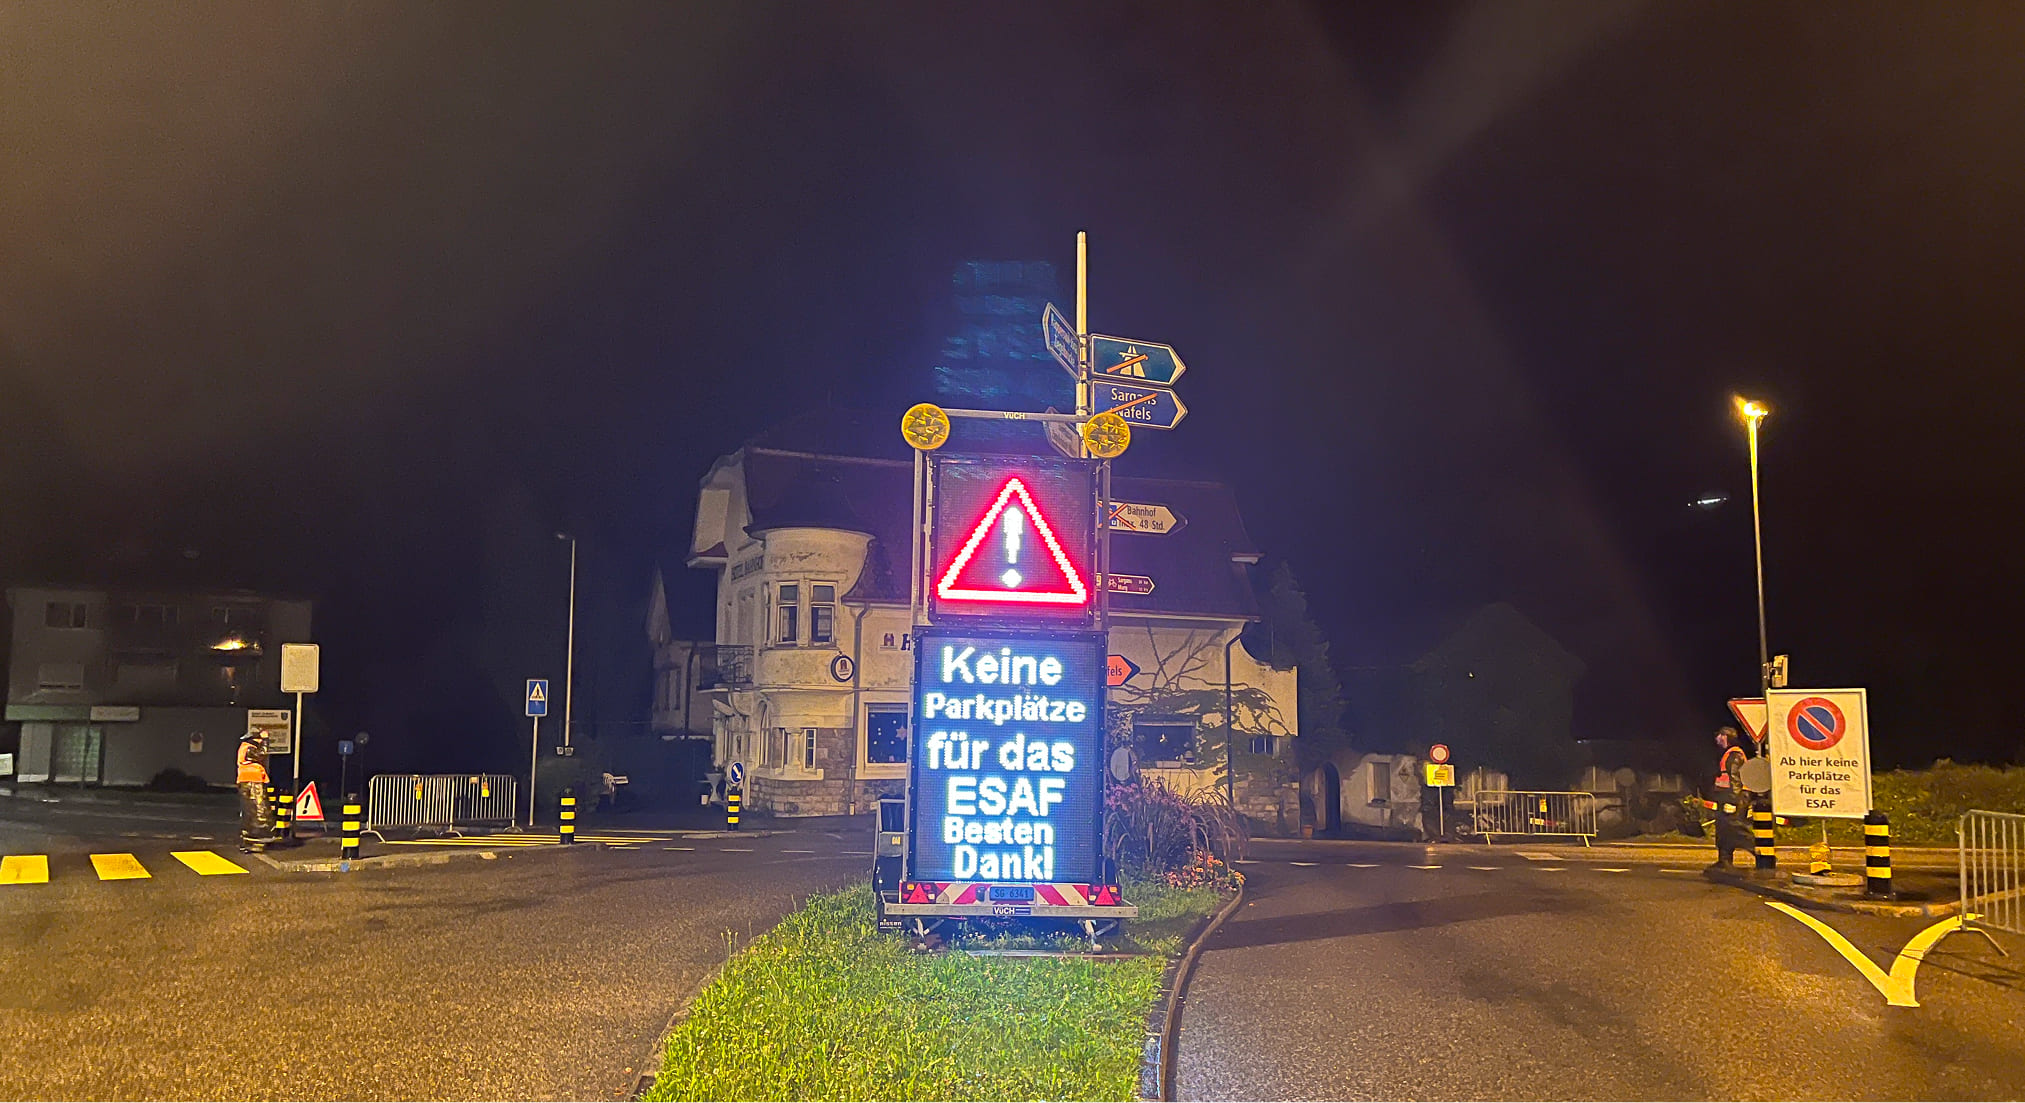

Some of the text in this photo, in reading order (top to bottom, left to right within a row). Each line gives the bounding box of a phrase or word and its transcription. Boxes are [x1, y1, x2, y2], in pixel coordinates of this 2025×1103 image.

[1111, 387, 1157, 405] Sars
[1127, 505, 1157, 517] Bahnhof
[1139, 519, 1149, 529] 48
[942, 645, 1062, 686] Keine
[925, 692, 1087, 726] Parkplätze
[927, 731, 1074, 772] für das
[1780, 757, 1859, 768] Ab hier keine
[1788, 770, 1851, 783] Parkplätze
[947, 776, 1066, 816] ESAF
[1800, 784, 1841, 795] für das
[1806, 799, 1836, 809] ESAF
[943, 816, 1054, 845] Besten
[954, 845, 1054, 880] Dank!
[994, 888, 1029, 898] SG 6341
[879, 918, 902, 926] nissen
